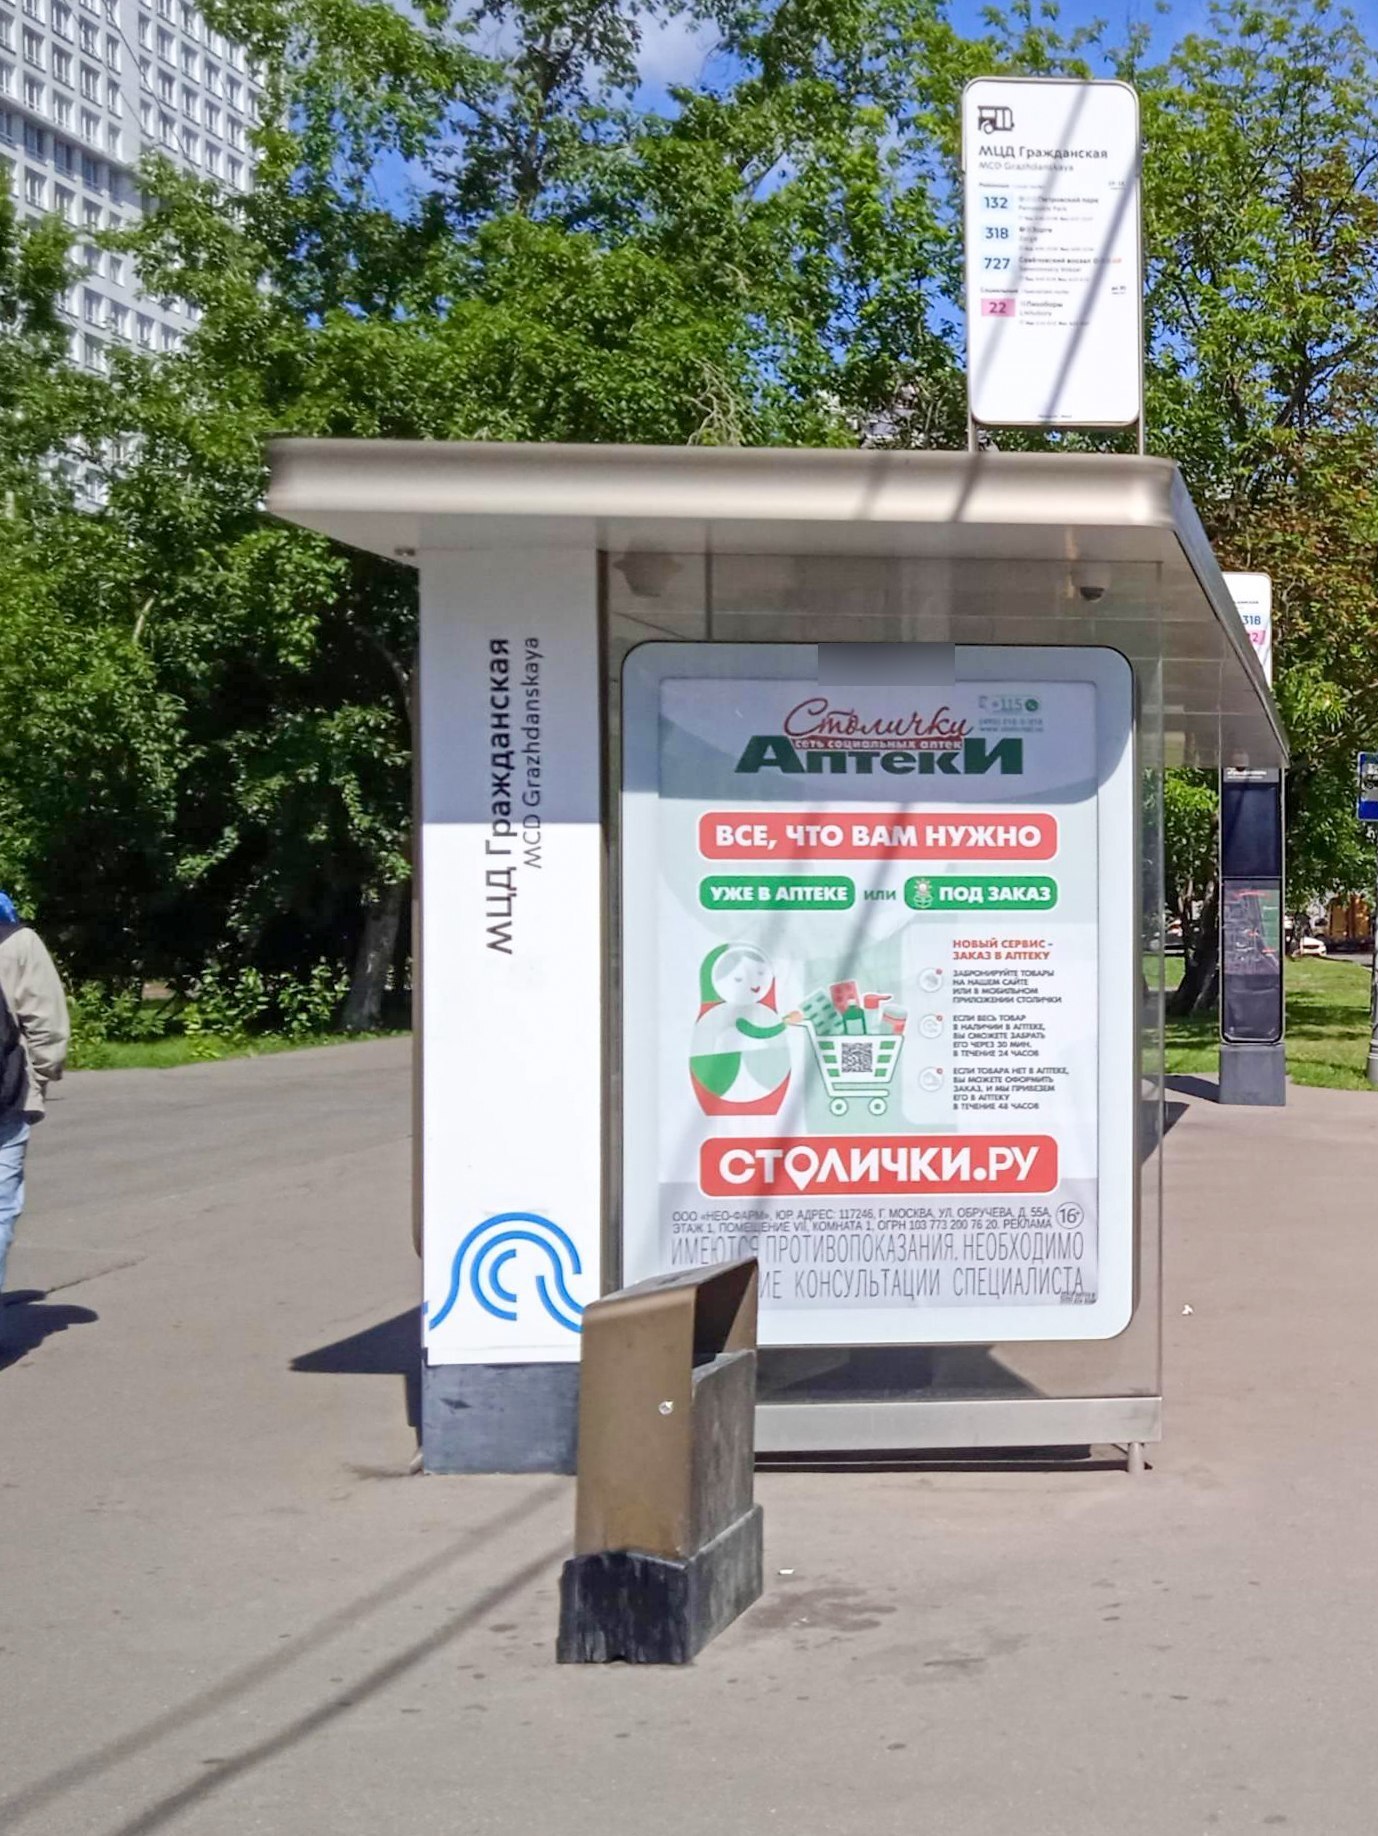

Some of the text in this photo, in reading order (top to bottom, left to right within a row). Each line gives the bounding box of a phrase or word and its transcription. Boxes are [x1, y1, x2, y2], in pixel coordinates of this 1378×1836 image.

[979, 145, 1108, 159] МЦД Гражданская
[984, 197, 1008, 209] 132
[985, 227, 1008, 239] 318
[984, 257, 1010, 269] 727
[989, 302, 1006, 313] 22
[1243, 615, 1261, 625] 318
[784, 697, 974, 737] Столички
[795, 740, 963, 751] сеть социальных аптек
[520, 637, 544, 869] MCD Grazhdanskaya
[485, 638, 517, 955] МЦД Гражданская
[715, 824, 1042, 850] ВСЕ, ЧТО ВАМ НУЖНО
[710, 885, 849, 901] УЖЕ В АПТЕКЕ
[939, 885, 1051, 903] ПОД ЗАКАЗ
[953, 938, 998, 948] НОВЫЙ
[1001, 940, 1046, 948] СЕРВИС
[953, 952, 1050, 960] ЗАКАЗ В АПТЕКУ
[1002, 977, 1028, 985] САЙТЕ
[718, 1146, 1039, 1191] СТОЛИЧКИ.РУ
[672, 1211, 698, 1221] ООО
[673, 1223, 703, 1234] ЭТАЖ
[812, 1221, 862, 1231] КОМНАТА
[877, 1220, 906, 1230] ОГРН
[909, 1220, 927, 1230] 103
[930, 1220, 947, 1229] 773
[950, 1220, 968, 1230] 200
[971, 1220, 983, 1230] 76
[1003, 1219, 1053, 1229] РЕКЛАМА
[671, 1231, 1085, 1265] ИМЕЮТСЯ ПРОТИВОПОКАЗАНИЯ. НЕОБХОДИМО
[794, 1268, 941, 1300] КОНСУЛЬТАЦИИ
[952, 1266, 1085, 1300] СПЕЦИАЛИСТА
